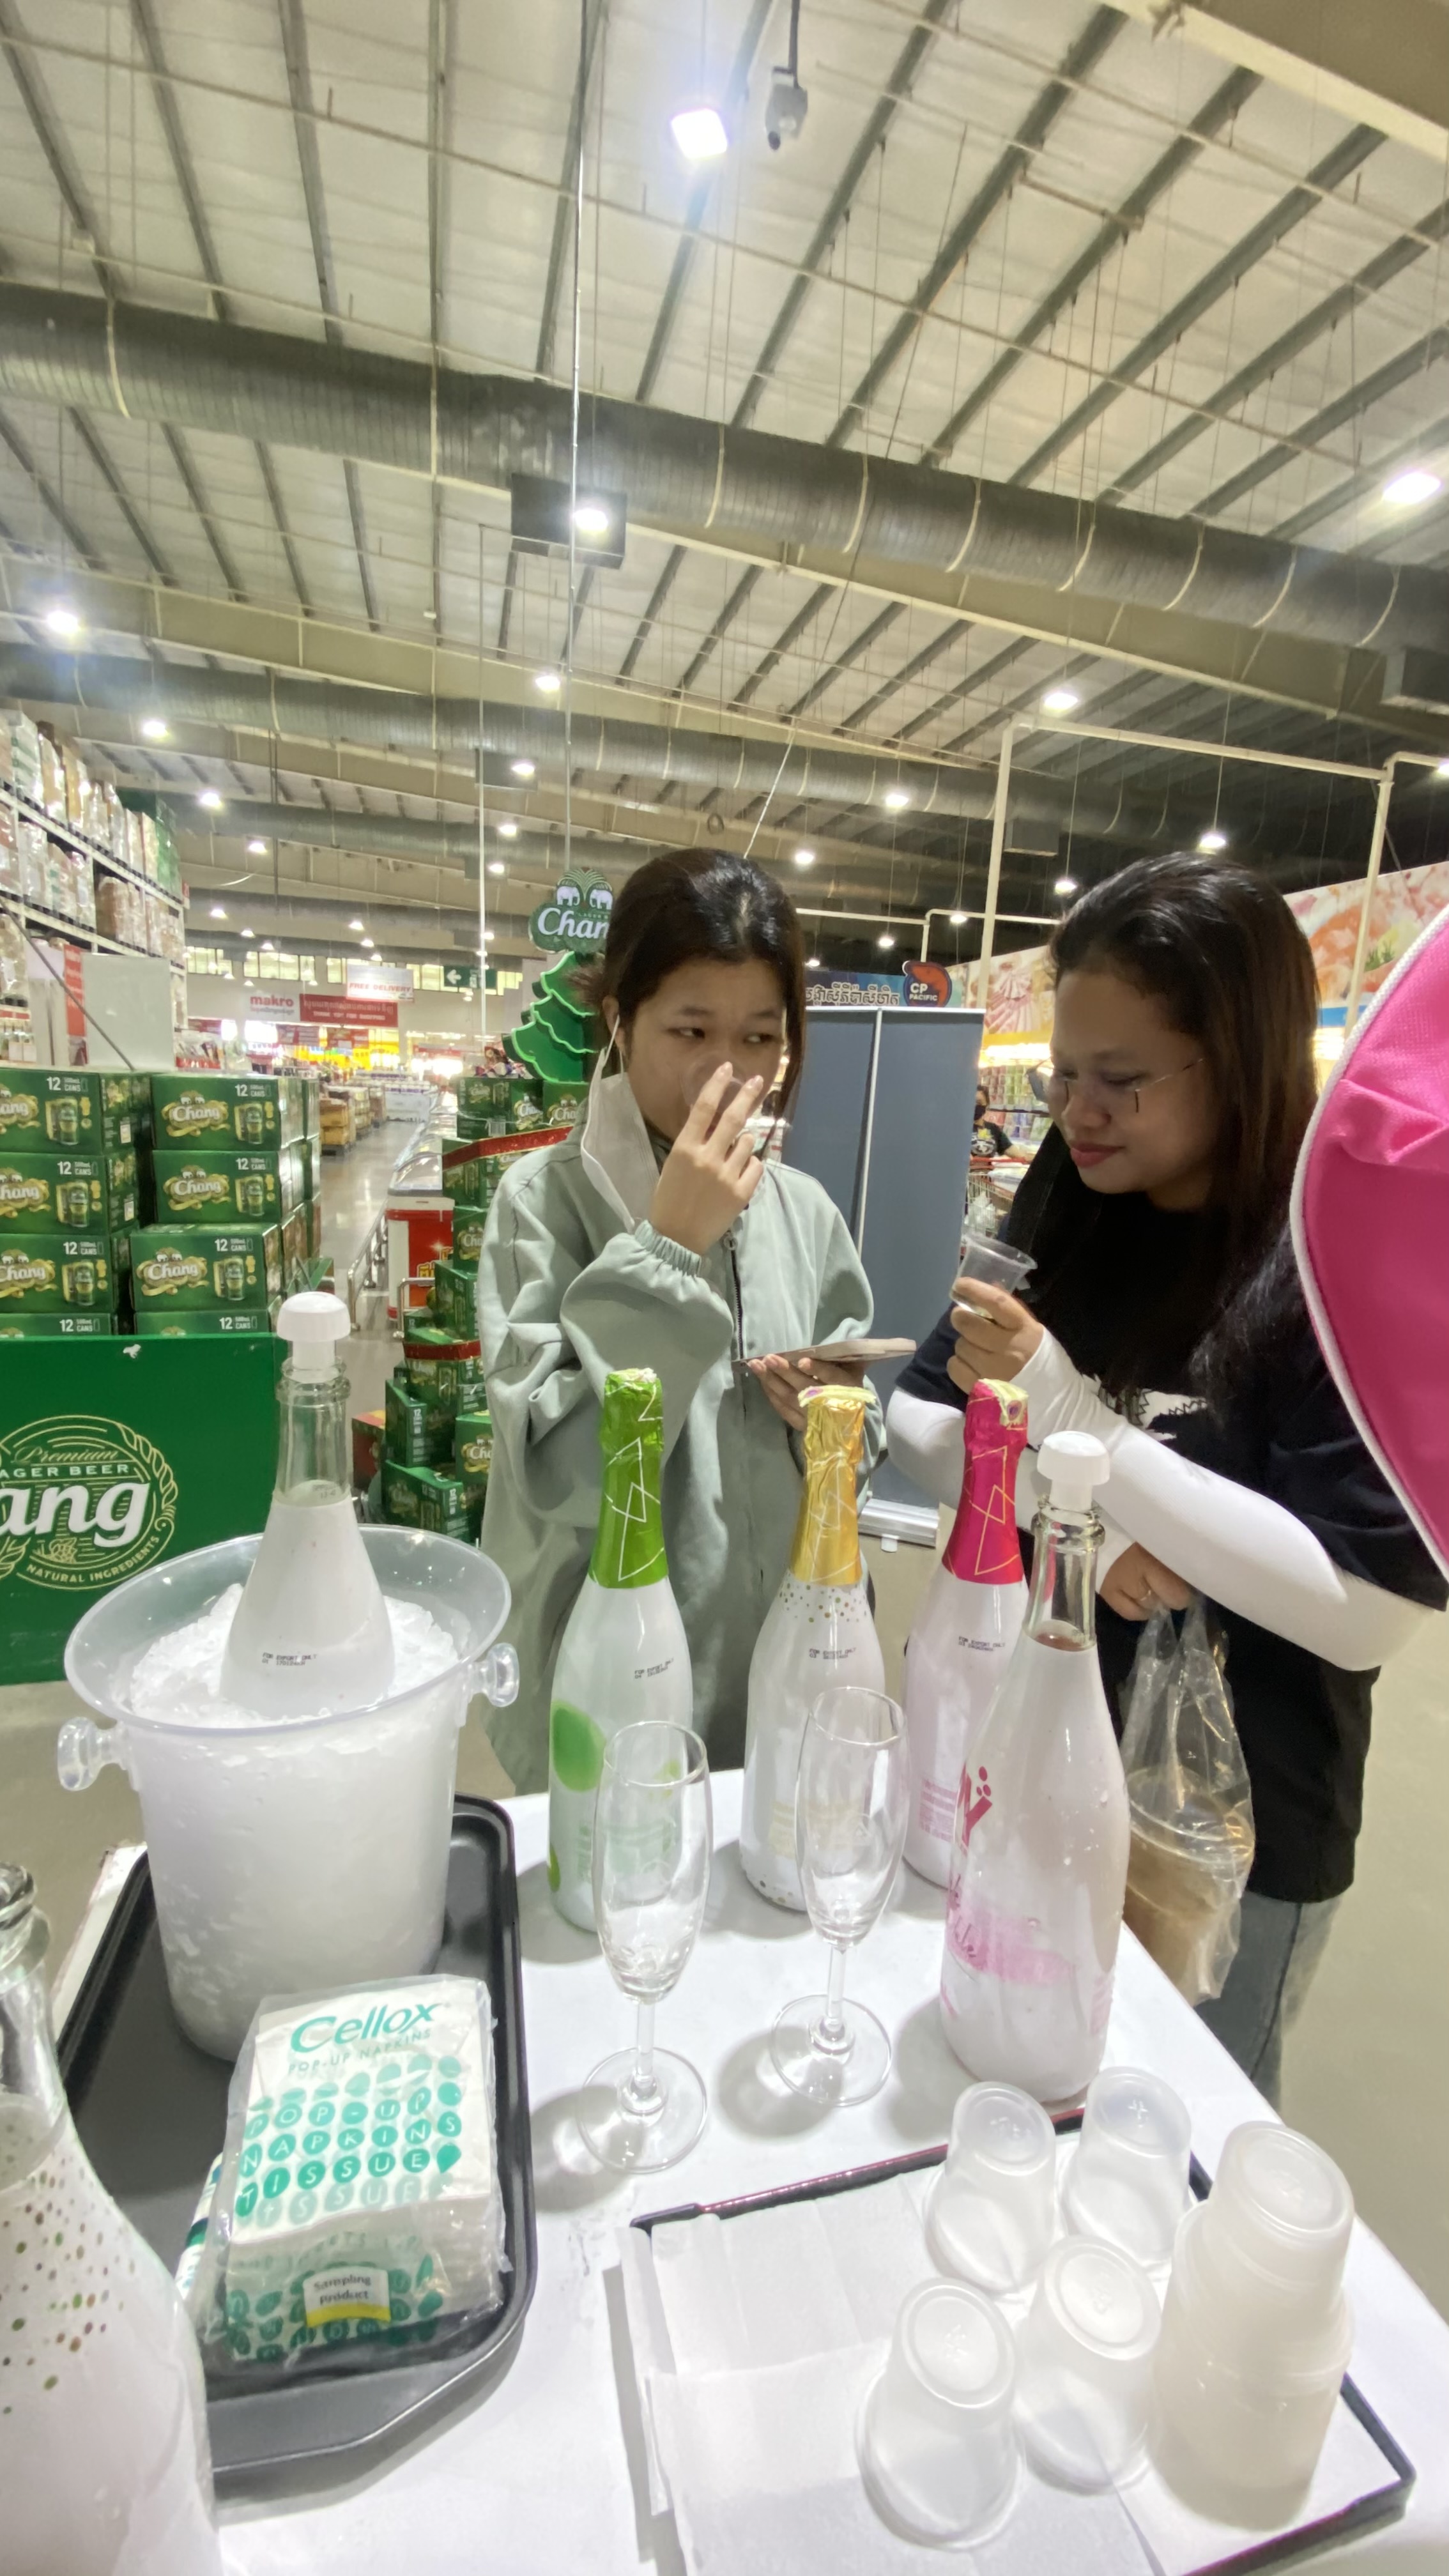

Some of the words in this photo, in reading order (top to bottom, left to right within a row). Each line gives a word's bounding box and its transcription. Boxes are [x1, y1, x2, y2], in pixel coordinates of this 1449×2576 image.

[538, 907, 610, 939] Chan
[372, 984, 411, 992] DELIVERY
[910, 982, 928, 994] CP
[250, 994, 295, 1008] makro
[47, 1077, 61, 1091] 12
[235, 1084, 248, 1097] 12
[0, 1103, 29, 1116] ang
[172, 1106, 220, 1122] Chang
[554, 1108, 576, 1121] Cha
[57, 1162, 72, 1175] 12
[236, 1158, 249, 1170] 12
[0, 1184, 40, 1200] hang
[174, 1180, 222, 1195] Chang
[63, 1241, 77, 1255] 12
[215, 1239, 228, 1252] 12
[148, 1263, 198, 1280] Chang
[59, 1319, 73, 1332] 12
[219, 1317, 233, 1330] 12
[10, 1445, 119, 1463] Premium
[0, 1467, 59, 1479] AGER
[70, 1464, 128, 1476] BEER
[0, 1483, 151, 1547] ang
[26, 1563, 85, 1583] NATURAL
[89, 1535, 160, 1581] INGREDIENTS
[290, 2002, 443, 2053] Cellox
[288, 2052, 351, 2075] POP-UP
[359, 2028, 432, 2060] NAPKINS
[243, 2117, 456, 2170] NAPKINS
[242, 2153, 424, 2207] TISSUE
[313, 2274, 371, 2291] Sampling
